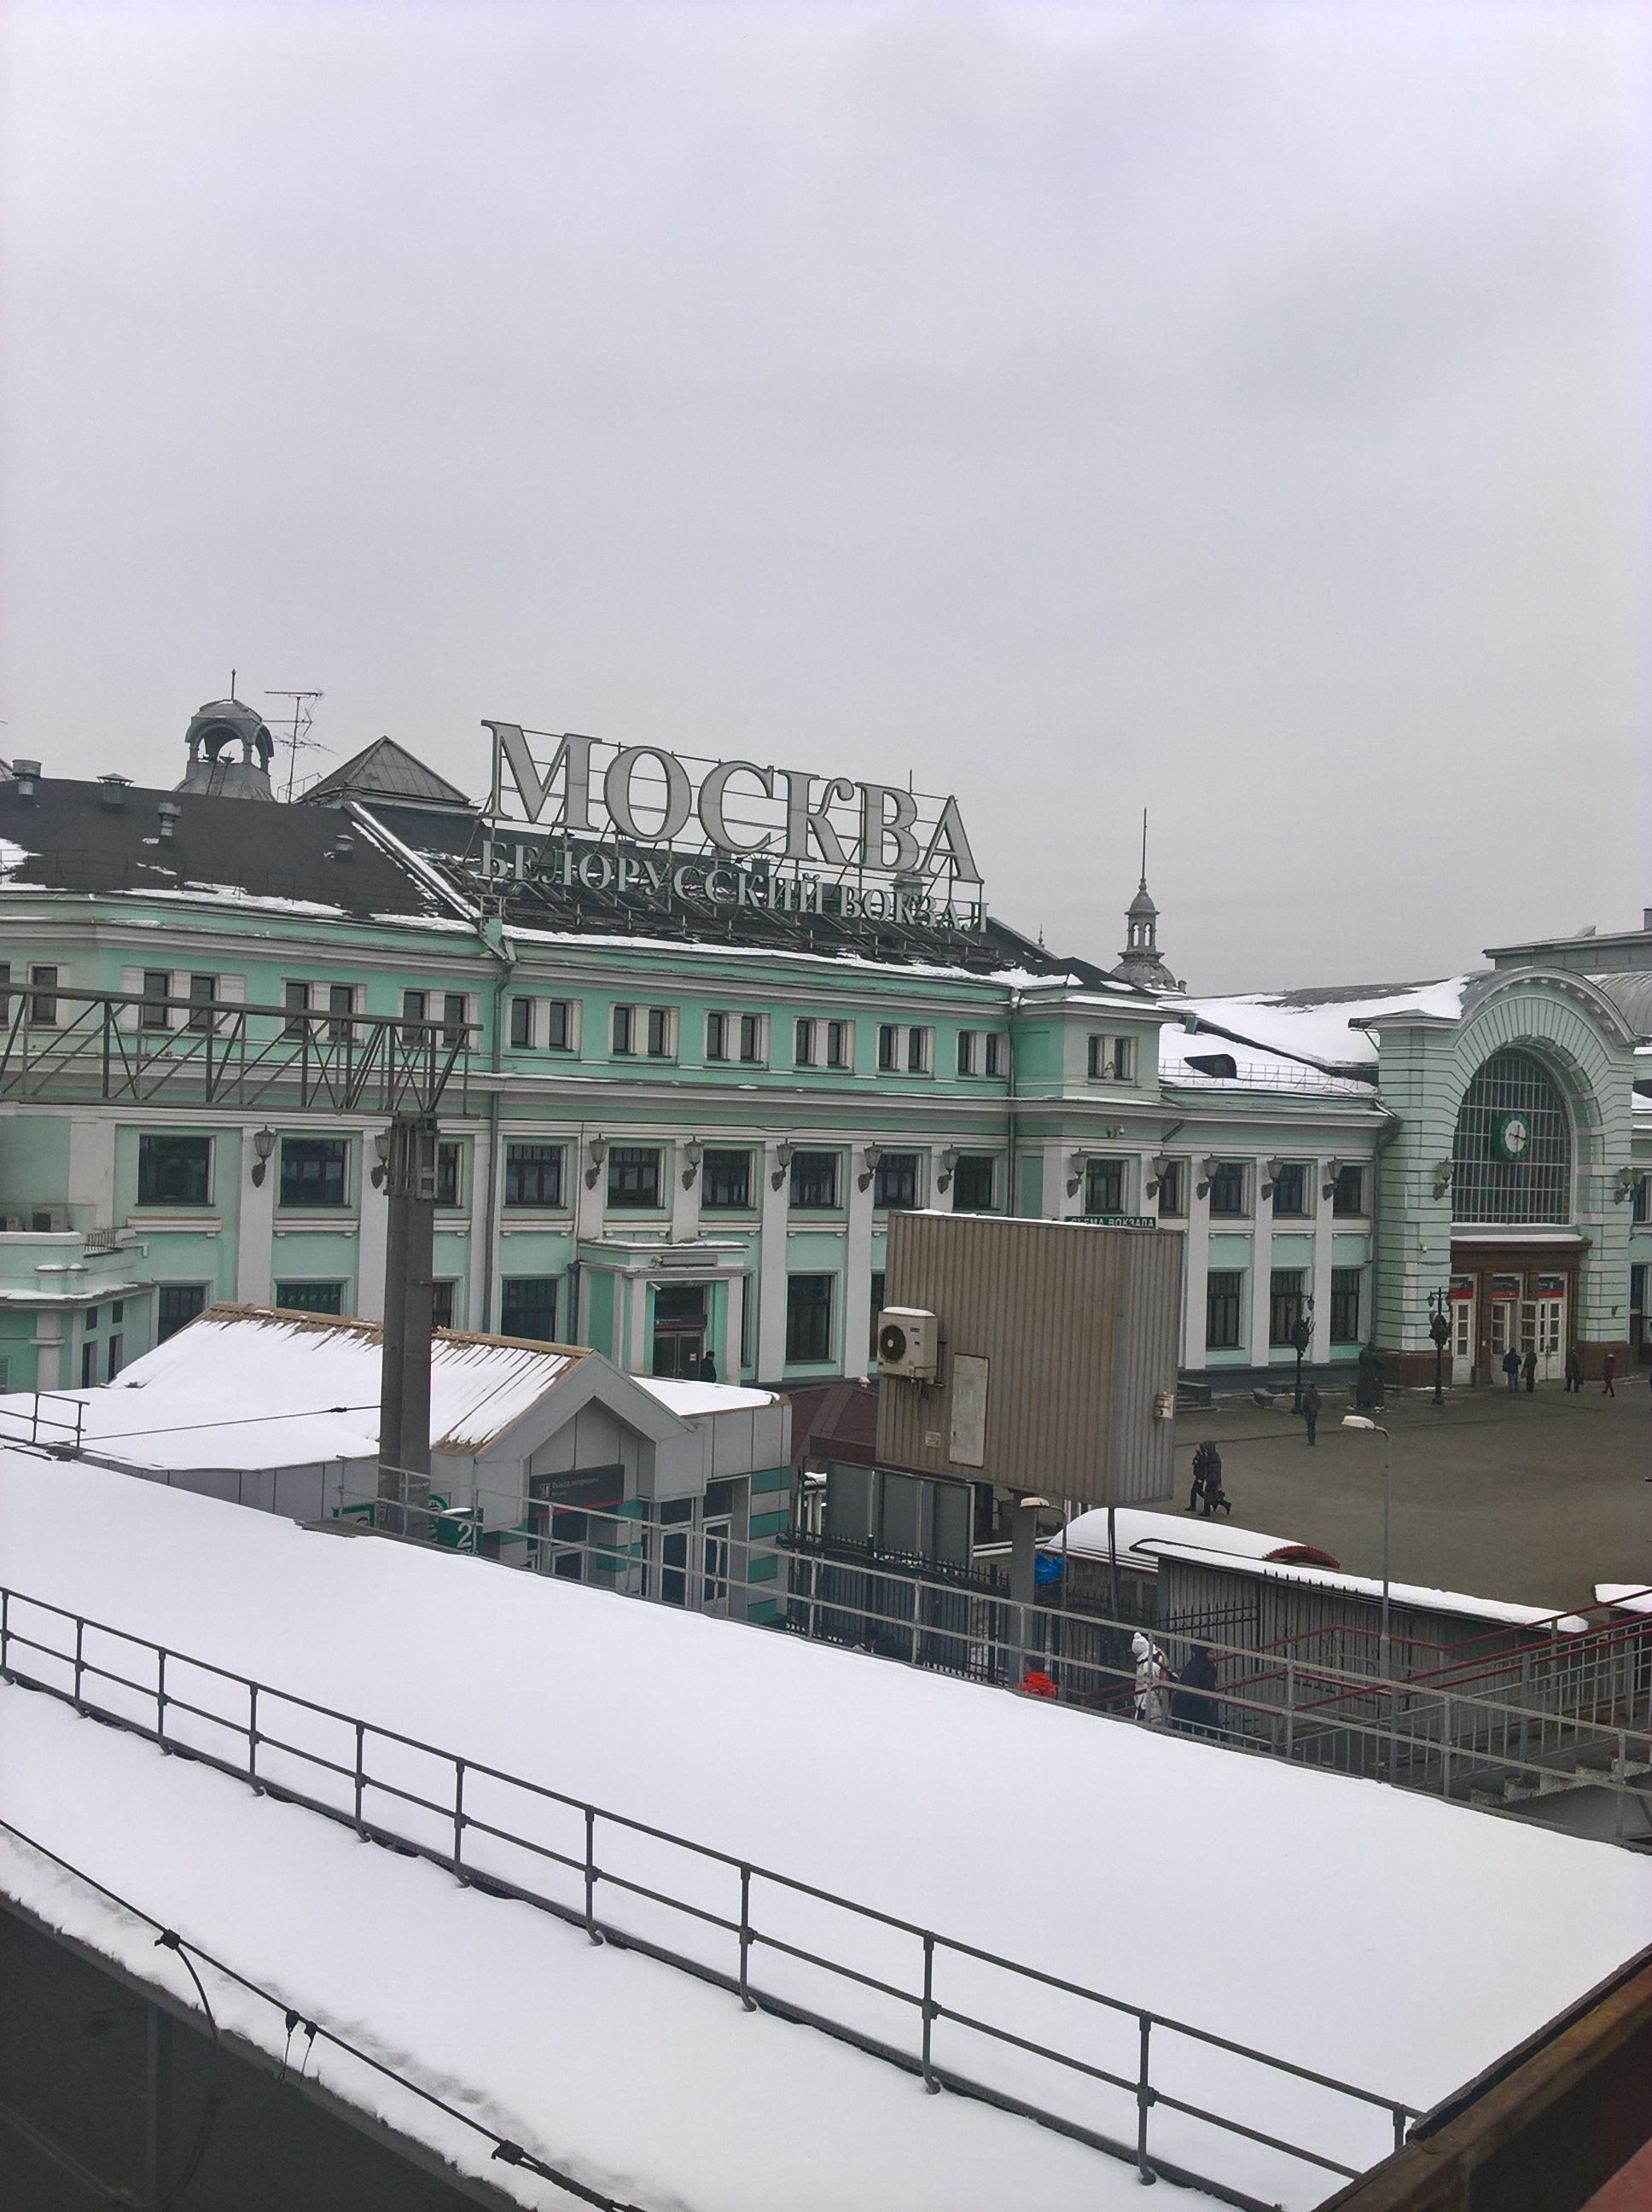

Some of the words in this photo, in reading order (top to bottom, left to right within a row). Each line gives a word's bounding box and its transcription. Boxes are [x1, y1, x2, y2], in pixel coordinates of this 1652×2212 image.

[480, 719, 984, 884] МОСКВА
[482, 841, 823, 915] БЕЛОРУССКИЙ
[841, 885, 990, 933] ВОКЗАЛ
